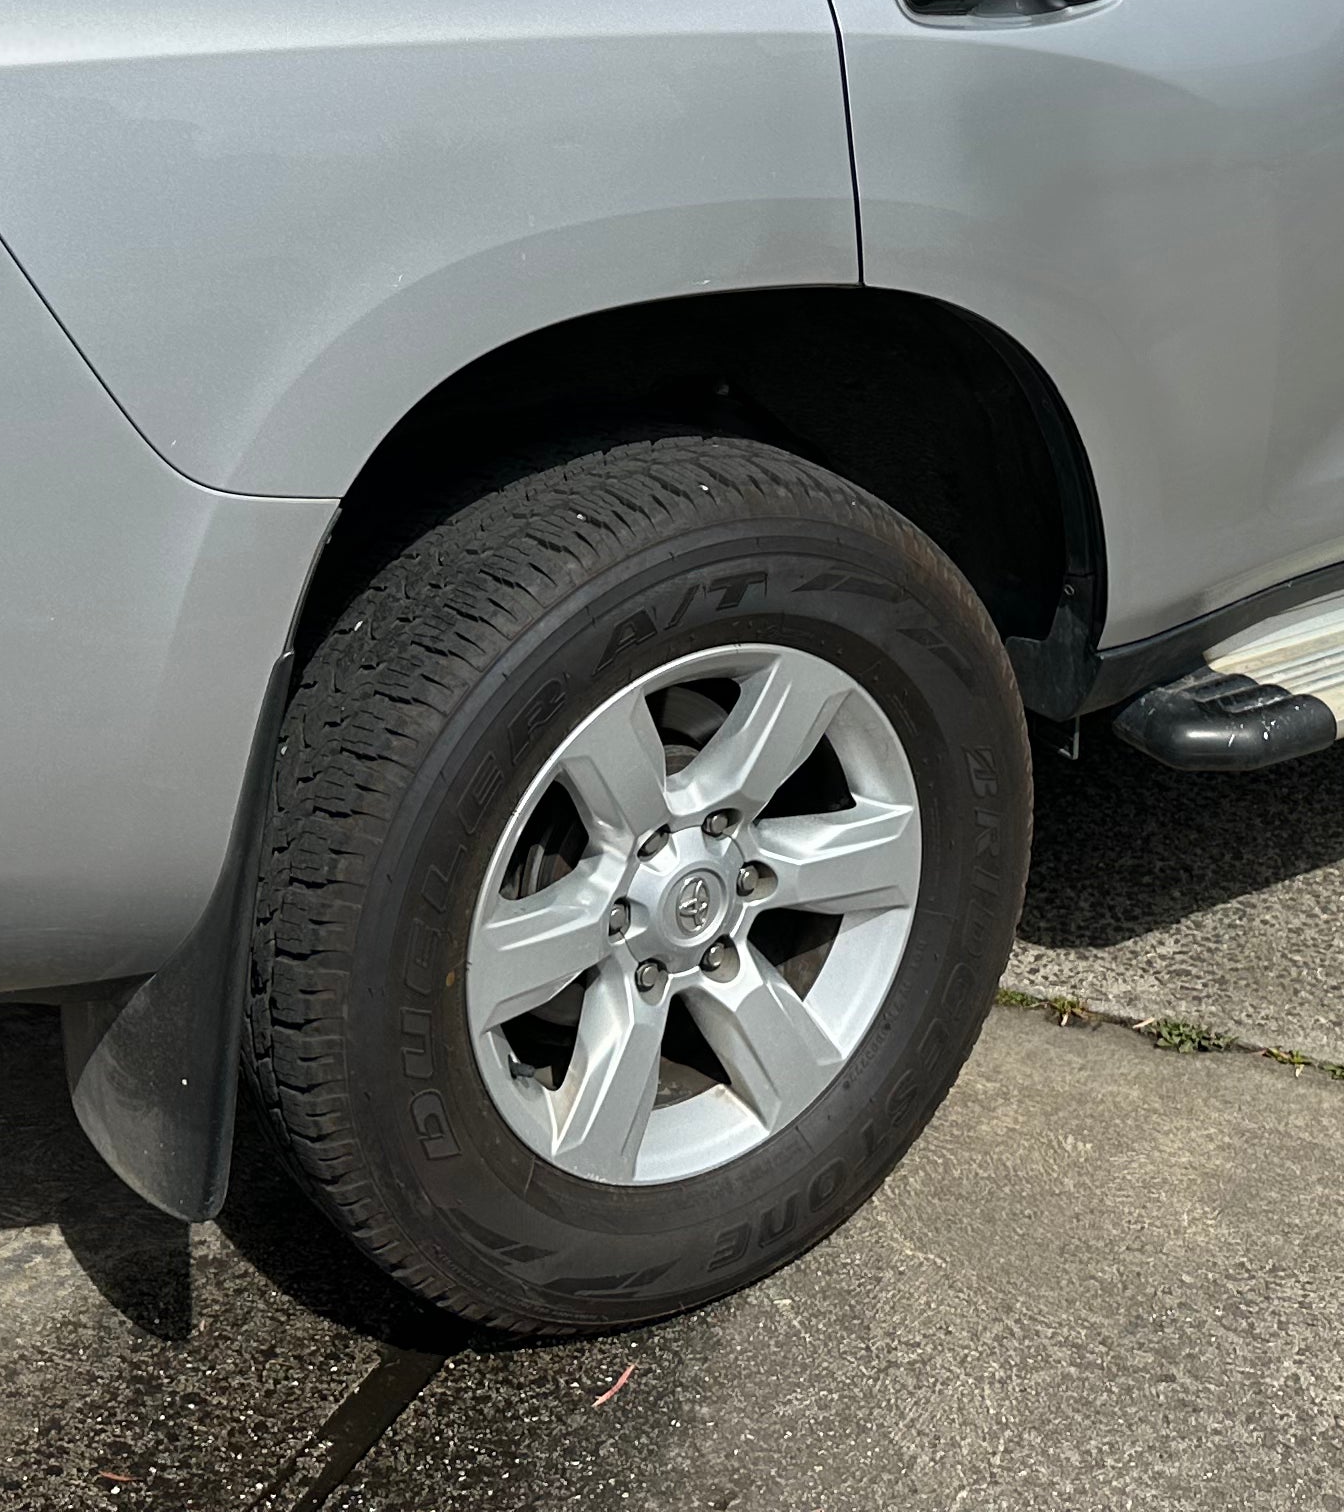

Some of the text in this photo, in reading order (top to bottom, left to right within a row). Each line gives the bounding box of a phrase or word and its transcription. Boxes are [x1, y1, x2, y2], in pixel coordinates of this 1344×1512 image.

[400, 571, 768, 1159] DUELER A/T
[707, 744, 1001, 1272] BRIDGESTONE
